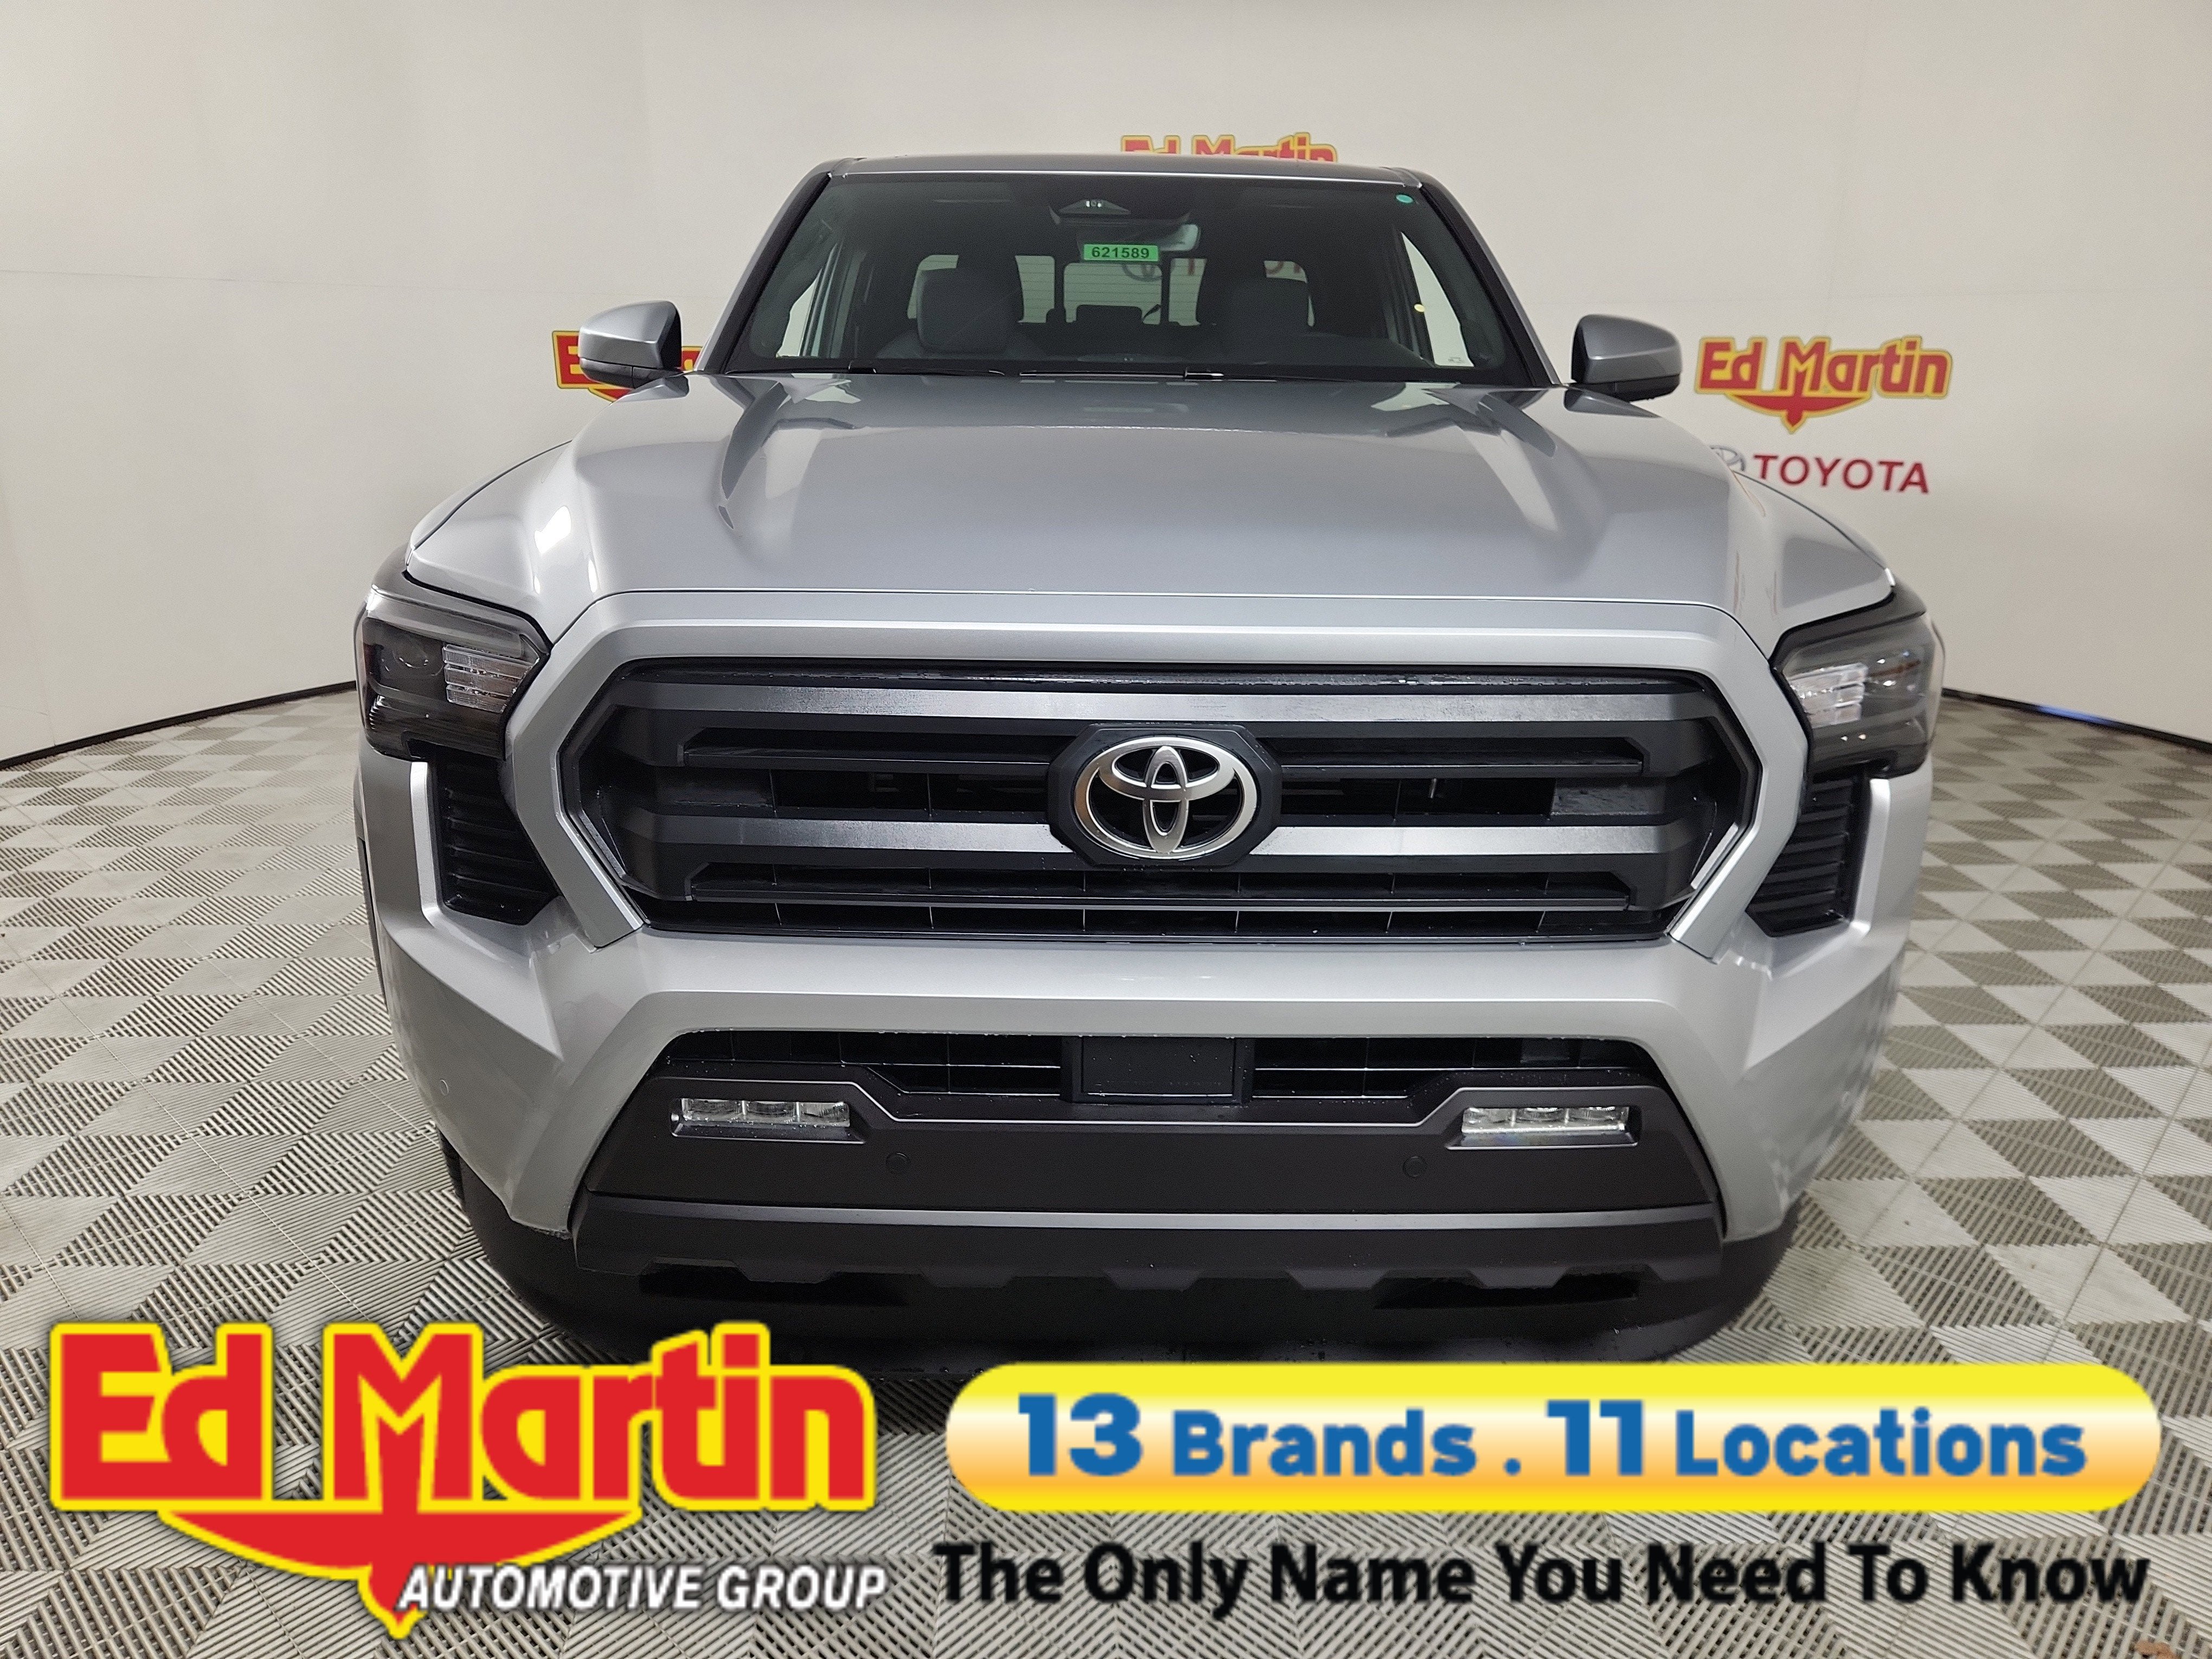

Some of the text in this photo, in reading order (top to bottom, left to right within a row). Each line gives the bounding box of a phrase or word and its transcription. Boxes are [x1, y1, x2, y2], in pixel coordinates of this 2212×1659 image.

[1091, 247, 1149, 259] 621589
[1699, 338, 1951, 396] Ed Martin
[1753, 454, 1930, 494] TOYOTA
